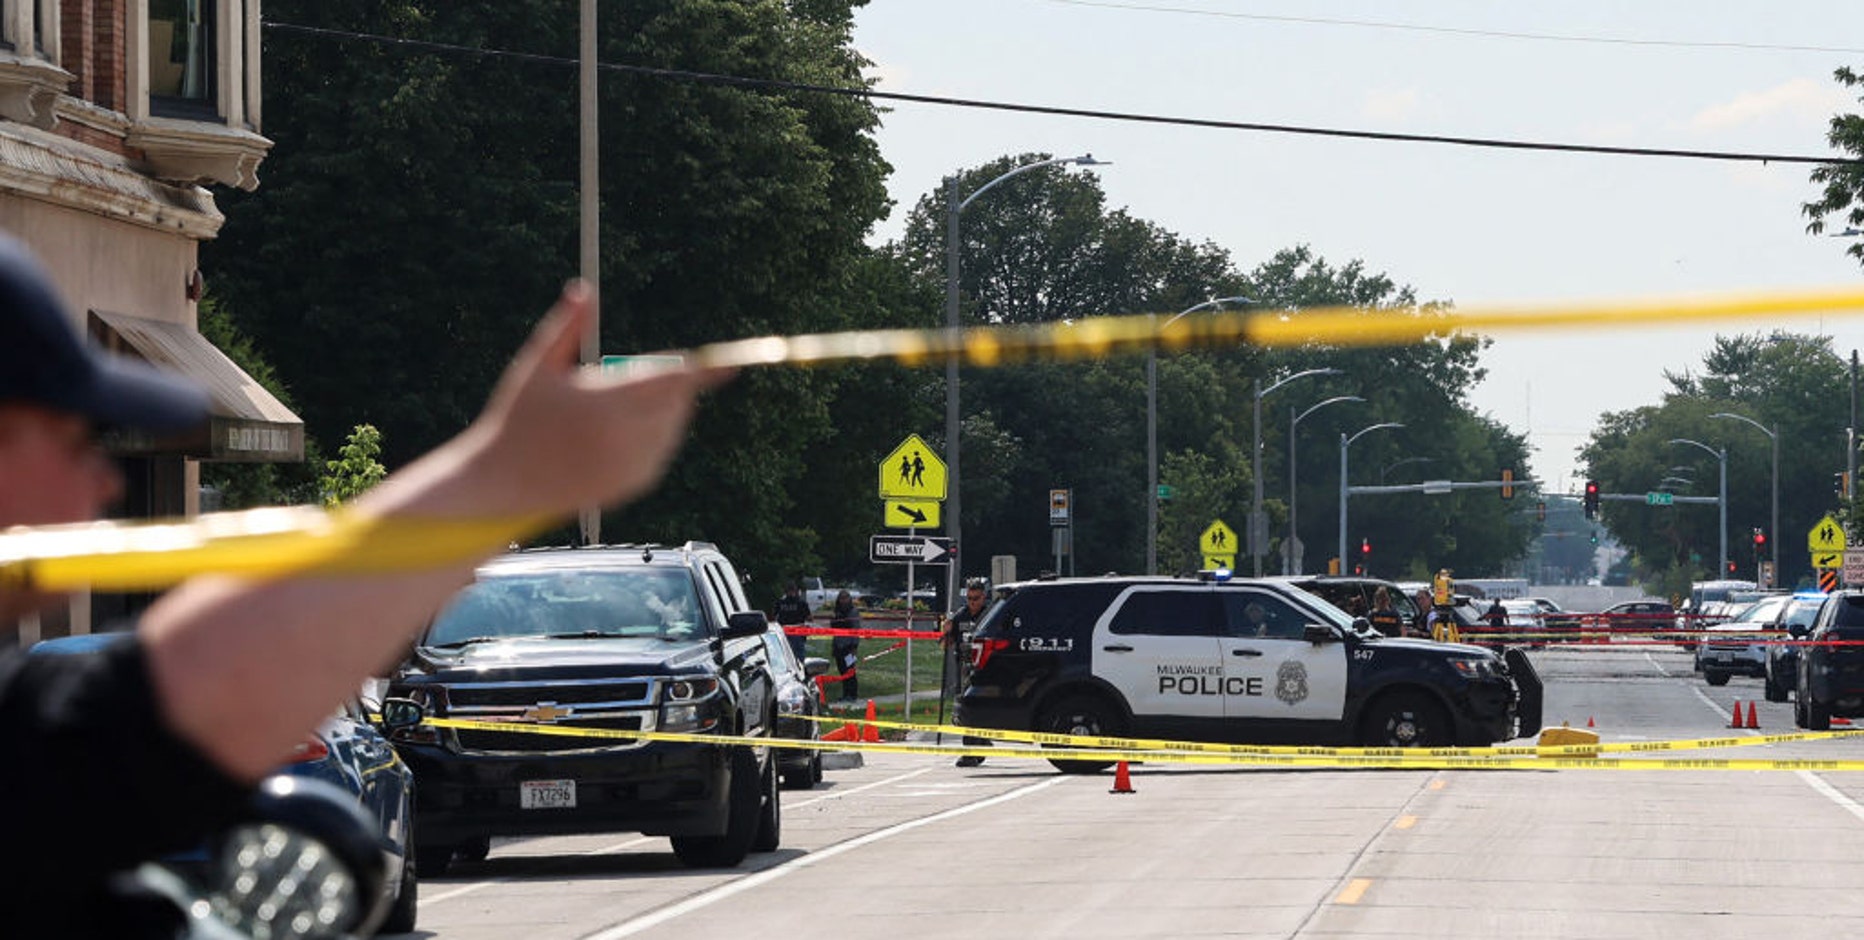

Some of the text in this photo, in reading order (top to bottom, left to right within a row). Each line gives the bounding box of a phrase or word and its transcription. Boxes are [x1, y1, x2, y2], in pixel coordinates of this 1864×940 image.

[879, 544, 923, 555] ONE WAY
[1013, 617, 1021, 627] 6
[1354, 650, 1375, 660] 547
[1157, 664, 1223, 675] MILWAUKEE
[1159, 677, 1263, 696] POLICE
